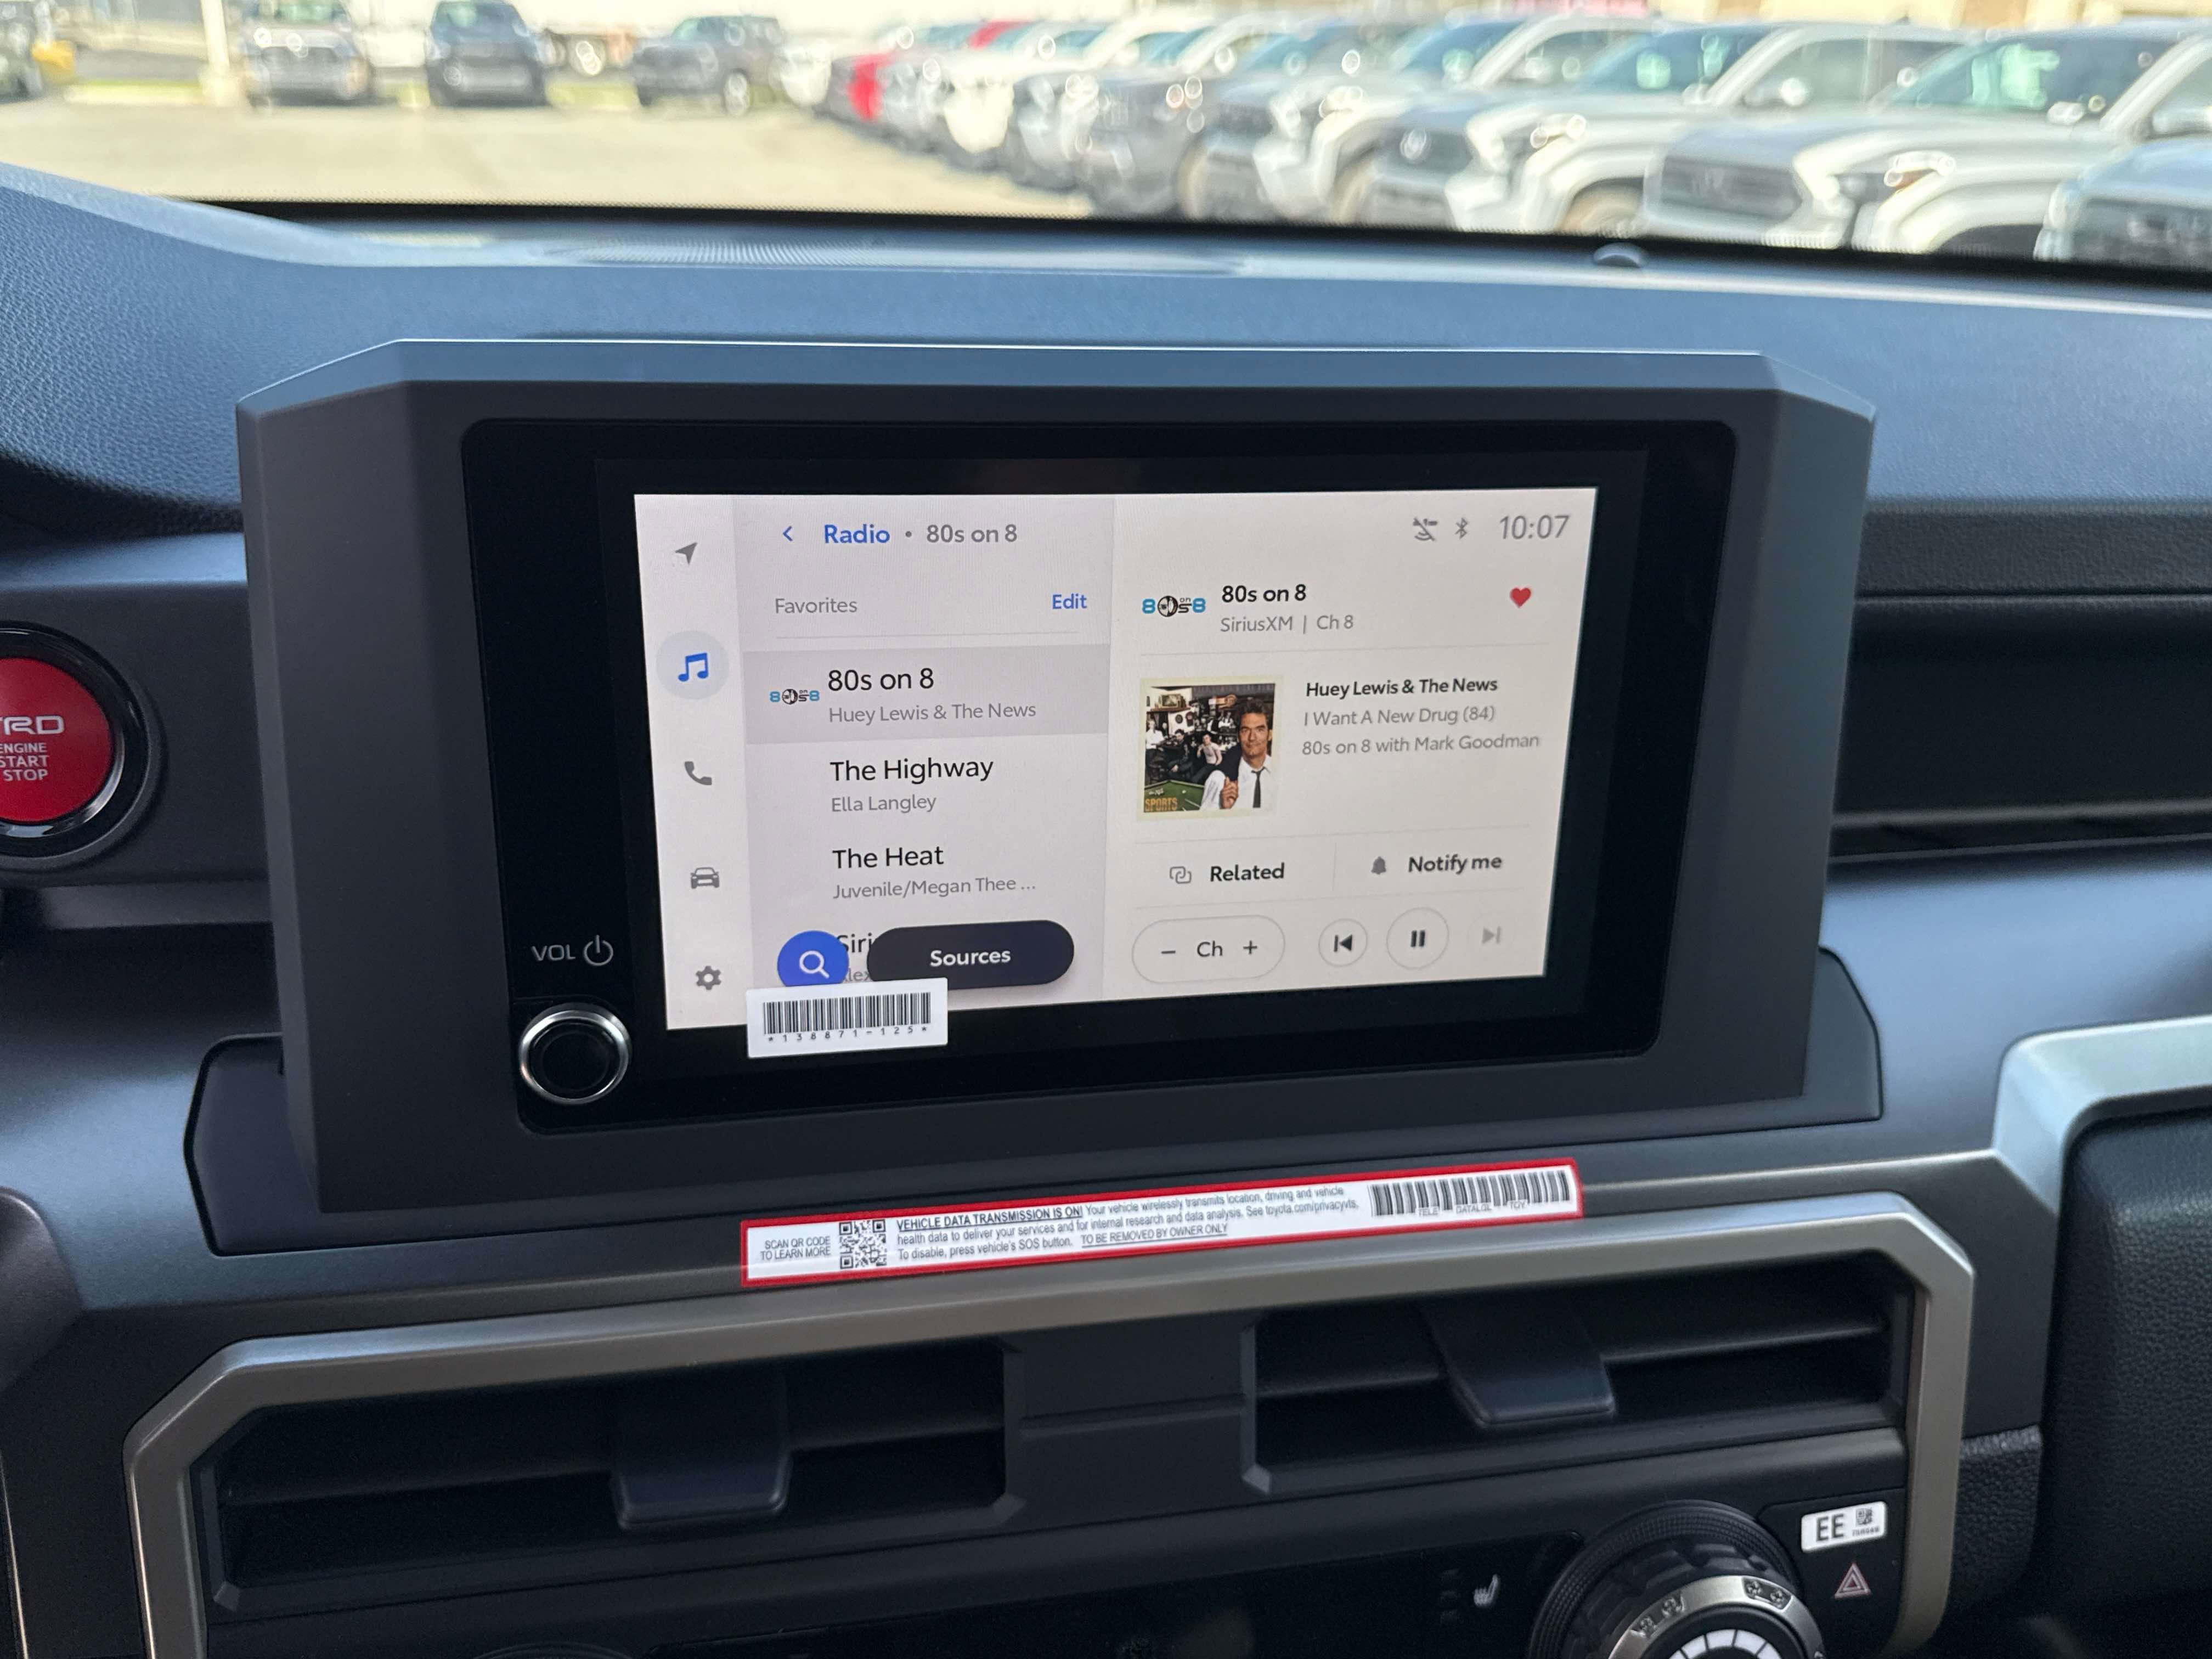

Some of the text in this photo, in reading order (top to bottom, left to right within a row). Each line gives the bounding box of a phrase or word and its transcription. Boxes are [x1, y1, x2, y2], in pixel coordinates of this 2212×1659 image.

[824, 523, 1018, 544] Radio 80s on 8
[1499, 515, 1570, 540] 10:07
[1052, 593, 1087, 610] Edit
[1222, 584, 1307, 603] 80s on 8
[775, 597, 857, 614] Favorites
[1220, 616, 1293, 633] SiriusXM
[1316, 614, 1339, 630] Ch
[1343, 614, 1353, 629] 8
[828, 668, 934, 691] 80s on 8
[1306, 678, 1498, 700] Huey Lewis & The News
[0, 715, 64, 735] RD
[829, 703, 1036, 726] Huey Lewis & The News
[1304, 705, 1495, 726] I Want A New Drug (84)
[1302, 733, 1540, 755] 80s on 8 with Mark Goodman
[3, 769, 49, 782] STOP
[830, 757, 994, 785] The Highway
[832, 794, 937, 814] Ella Langley
[1145, 797, 1177, 811] SPORTS
[832, 846, 944, 869] The Heat
[1408, 854, 1503, 875] Notify me
[1210, 862, 1285, 882] Related
[833, 880, 971, 899] Juvenile/Megan
[975, 877, 1016, 891] Thee
[531, 944, 576, 961] VOL
[930, 950, 1011, 967] Sources
[1197, 940, 1223, 957] Ch
[896, 1217, 941, 1230] VEHICLE
[944, 1214, 971, 1227] DATA
[973, 1207, 1050, 1224] TRANSMISSION
[1053, 1207, 1062, 1218] IS
[1085, 1204, 1105, 1216] Your
[1109, 1201, 1138, 1213] vehicle
[1141, 1198, 1183, 1210] wirelessly
[1185, 1195, 1224, 1207] transmits
[1227, 1193, 1263, 1204] location,
[1265, 1190, 1294, 1202] driving
[1296, 1188, 1312, 1199] and
[1316, 1185, 1344, 1197] vehicle
[898, 1233, 925, 1245] health
[928, 1232, 948, 1243] data
[951, 1231, 960, 1241] to
[963, 1228, 992, 1240] deliver
[996, 1227, 1015, 1240] your
[1018, 1223, 1054, 1235] services
[1057, 1221, 1074, 1232] and
[1076, 1219, 1088, 1231] for
[1091, 1216, 1124, 1228] internal
[1126, 1214, 1164, 1226] research
[1166, 1212, 1182, 1223] and
[1185, 1211, 1204, 1221] data
[1246, 1205, 1263, 1217] See
[765, 1235, 831, 1250] SCAN QR CODE
[898, 1223, 1228, 1260] To disable, press vehicle's SOS button. TO BE REMOVED BY OWNER ONLY
[760, 1246, 831, 1261] TO LEARN MORE
[1816, 1513, 1844, 1542] EE
